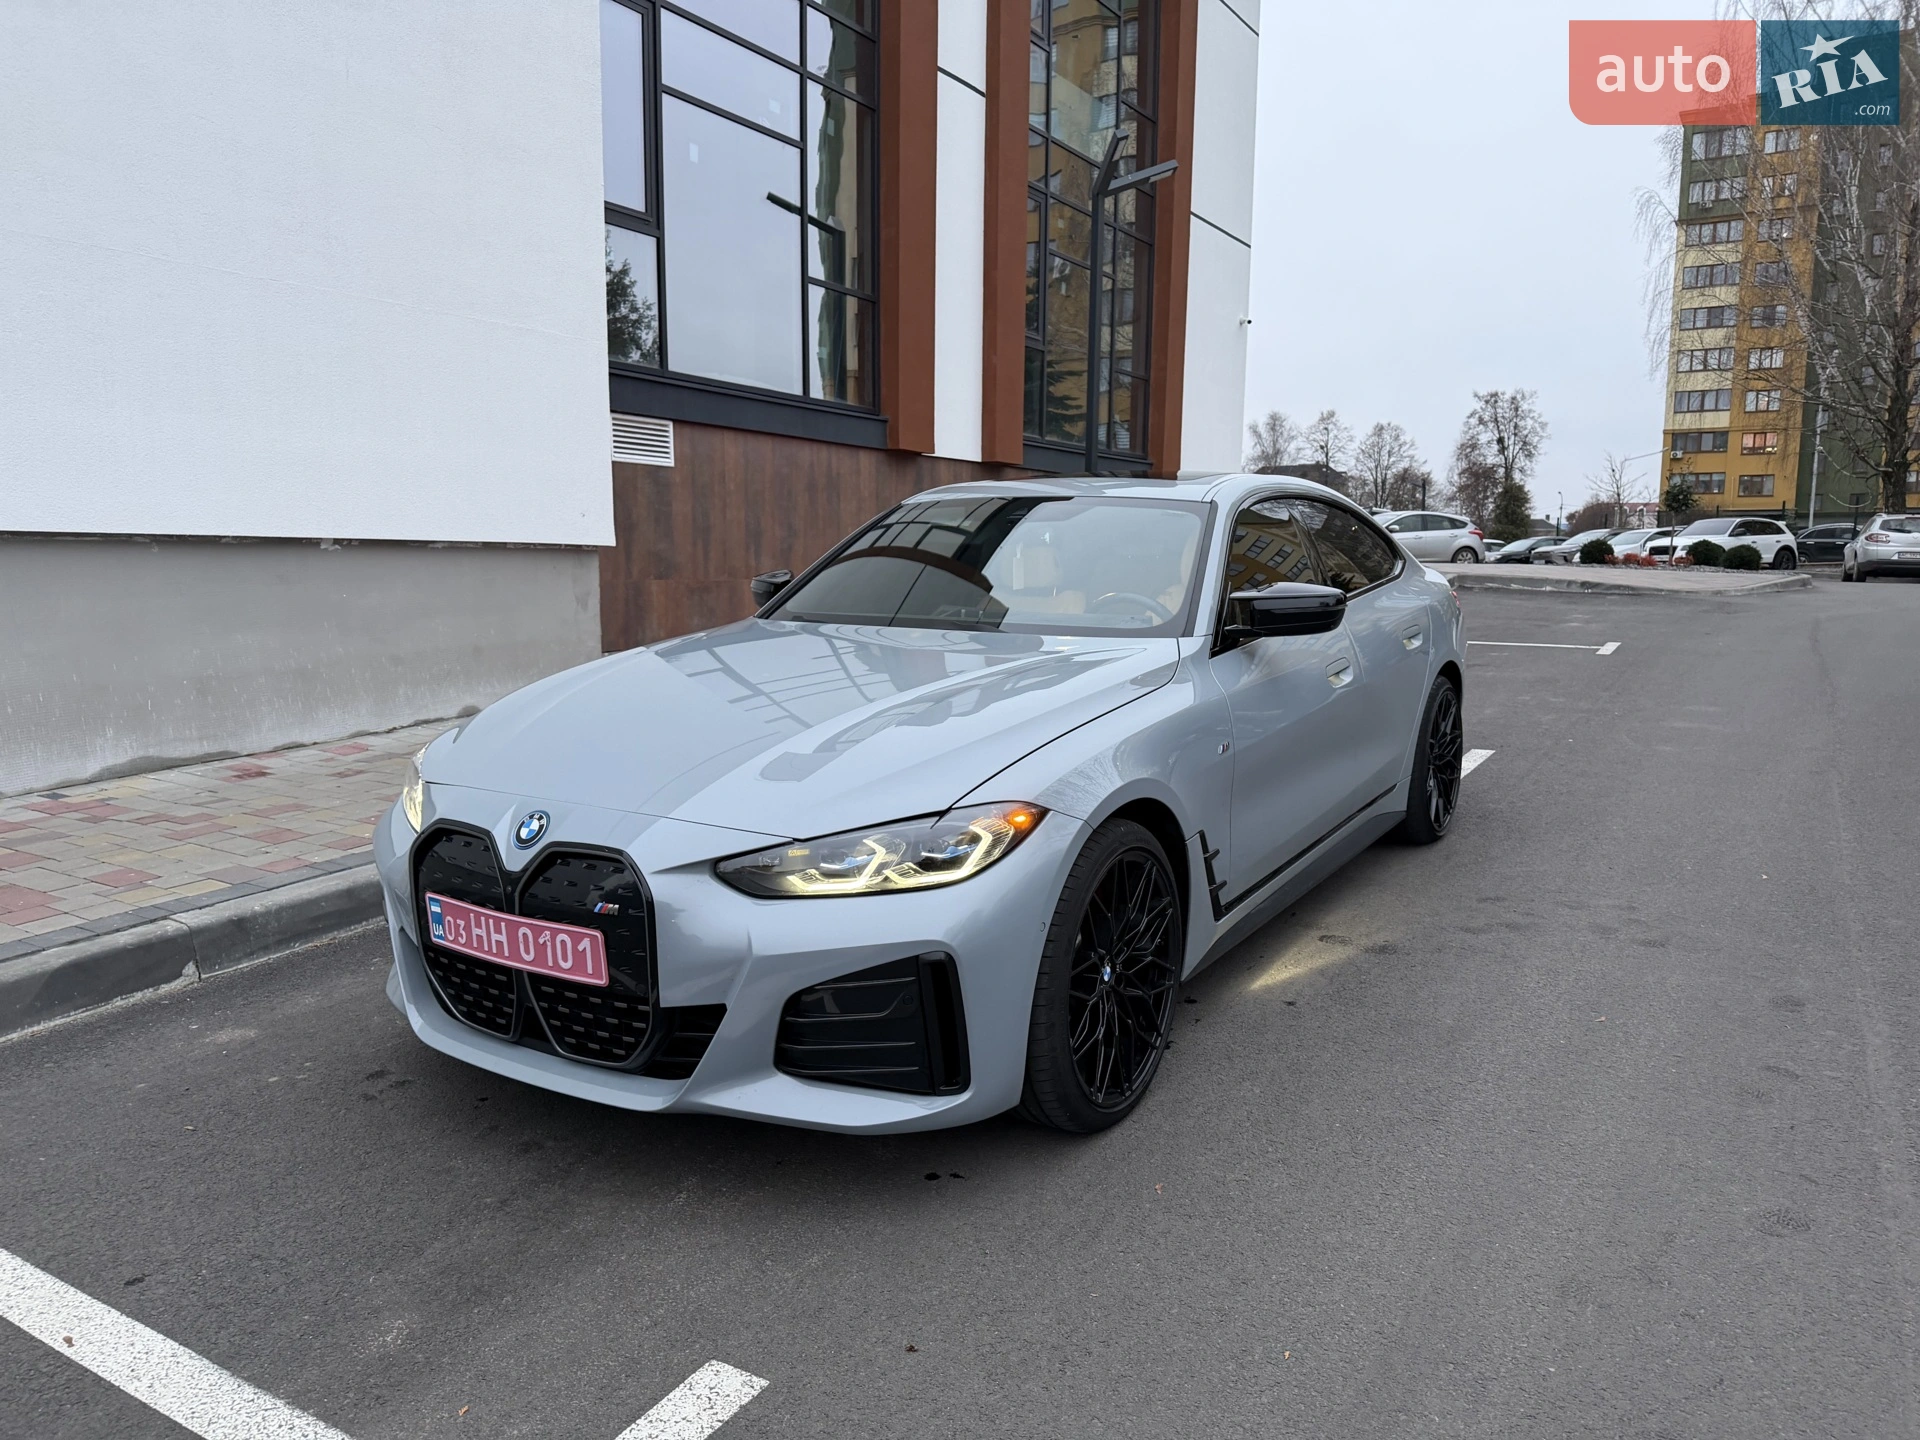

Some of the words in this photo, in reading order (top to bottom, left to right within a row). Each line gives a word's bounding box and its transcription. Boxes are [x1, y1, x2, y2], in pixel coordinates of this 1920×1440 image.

[433, 922, 444, 936] UA
[444, 916, 467, 945] 03
[518, 927, 593, 974] 0101
